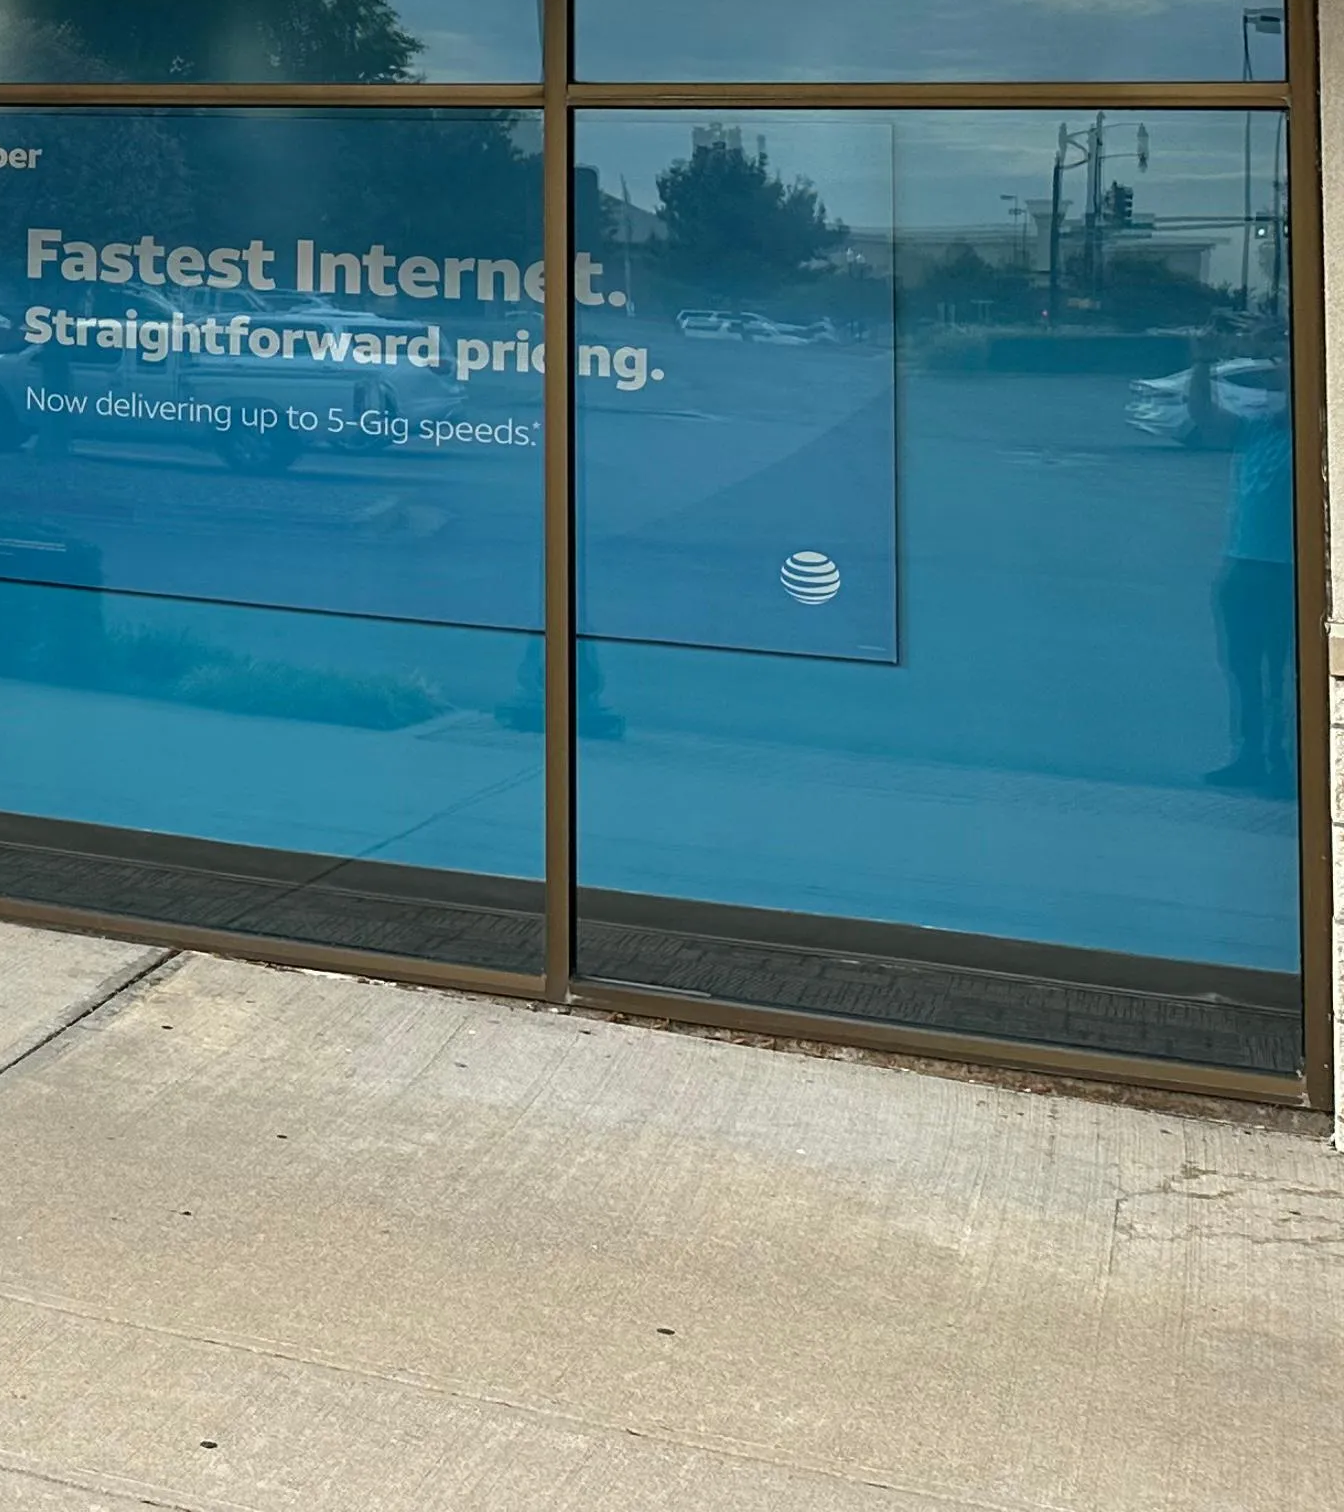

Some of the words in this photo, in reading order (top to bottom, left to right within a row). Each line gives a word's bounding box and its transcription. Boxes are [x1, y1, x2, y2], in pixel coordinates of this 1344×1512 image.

[26, 228, 277, 291] Fastest
[296, 238, 627, 307] Internet.
[24, 306, 441, 368] Straightforward
[456, 328, 665, 392] pricng.
[26, 385, 88, 414] Now
[95, 390, 232, 432] delivering
[241, 406, 278, 434] up
[285, 405, 319, 431] to
[327, 407, 409, 445] 5-Gig
